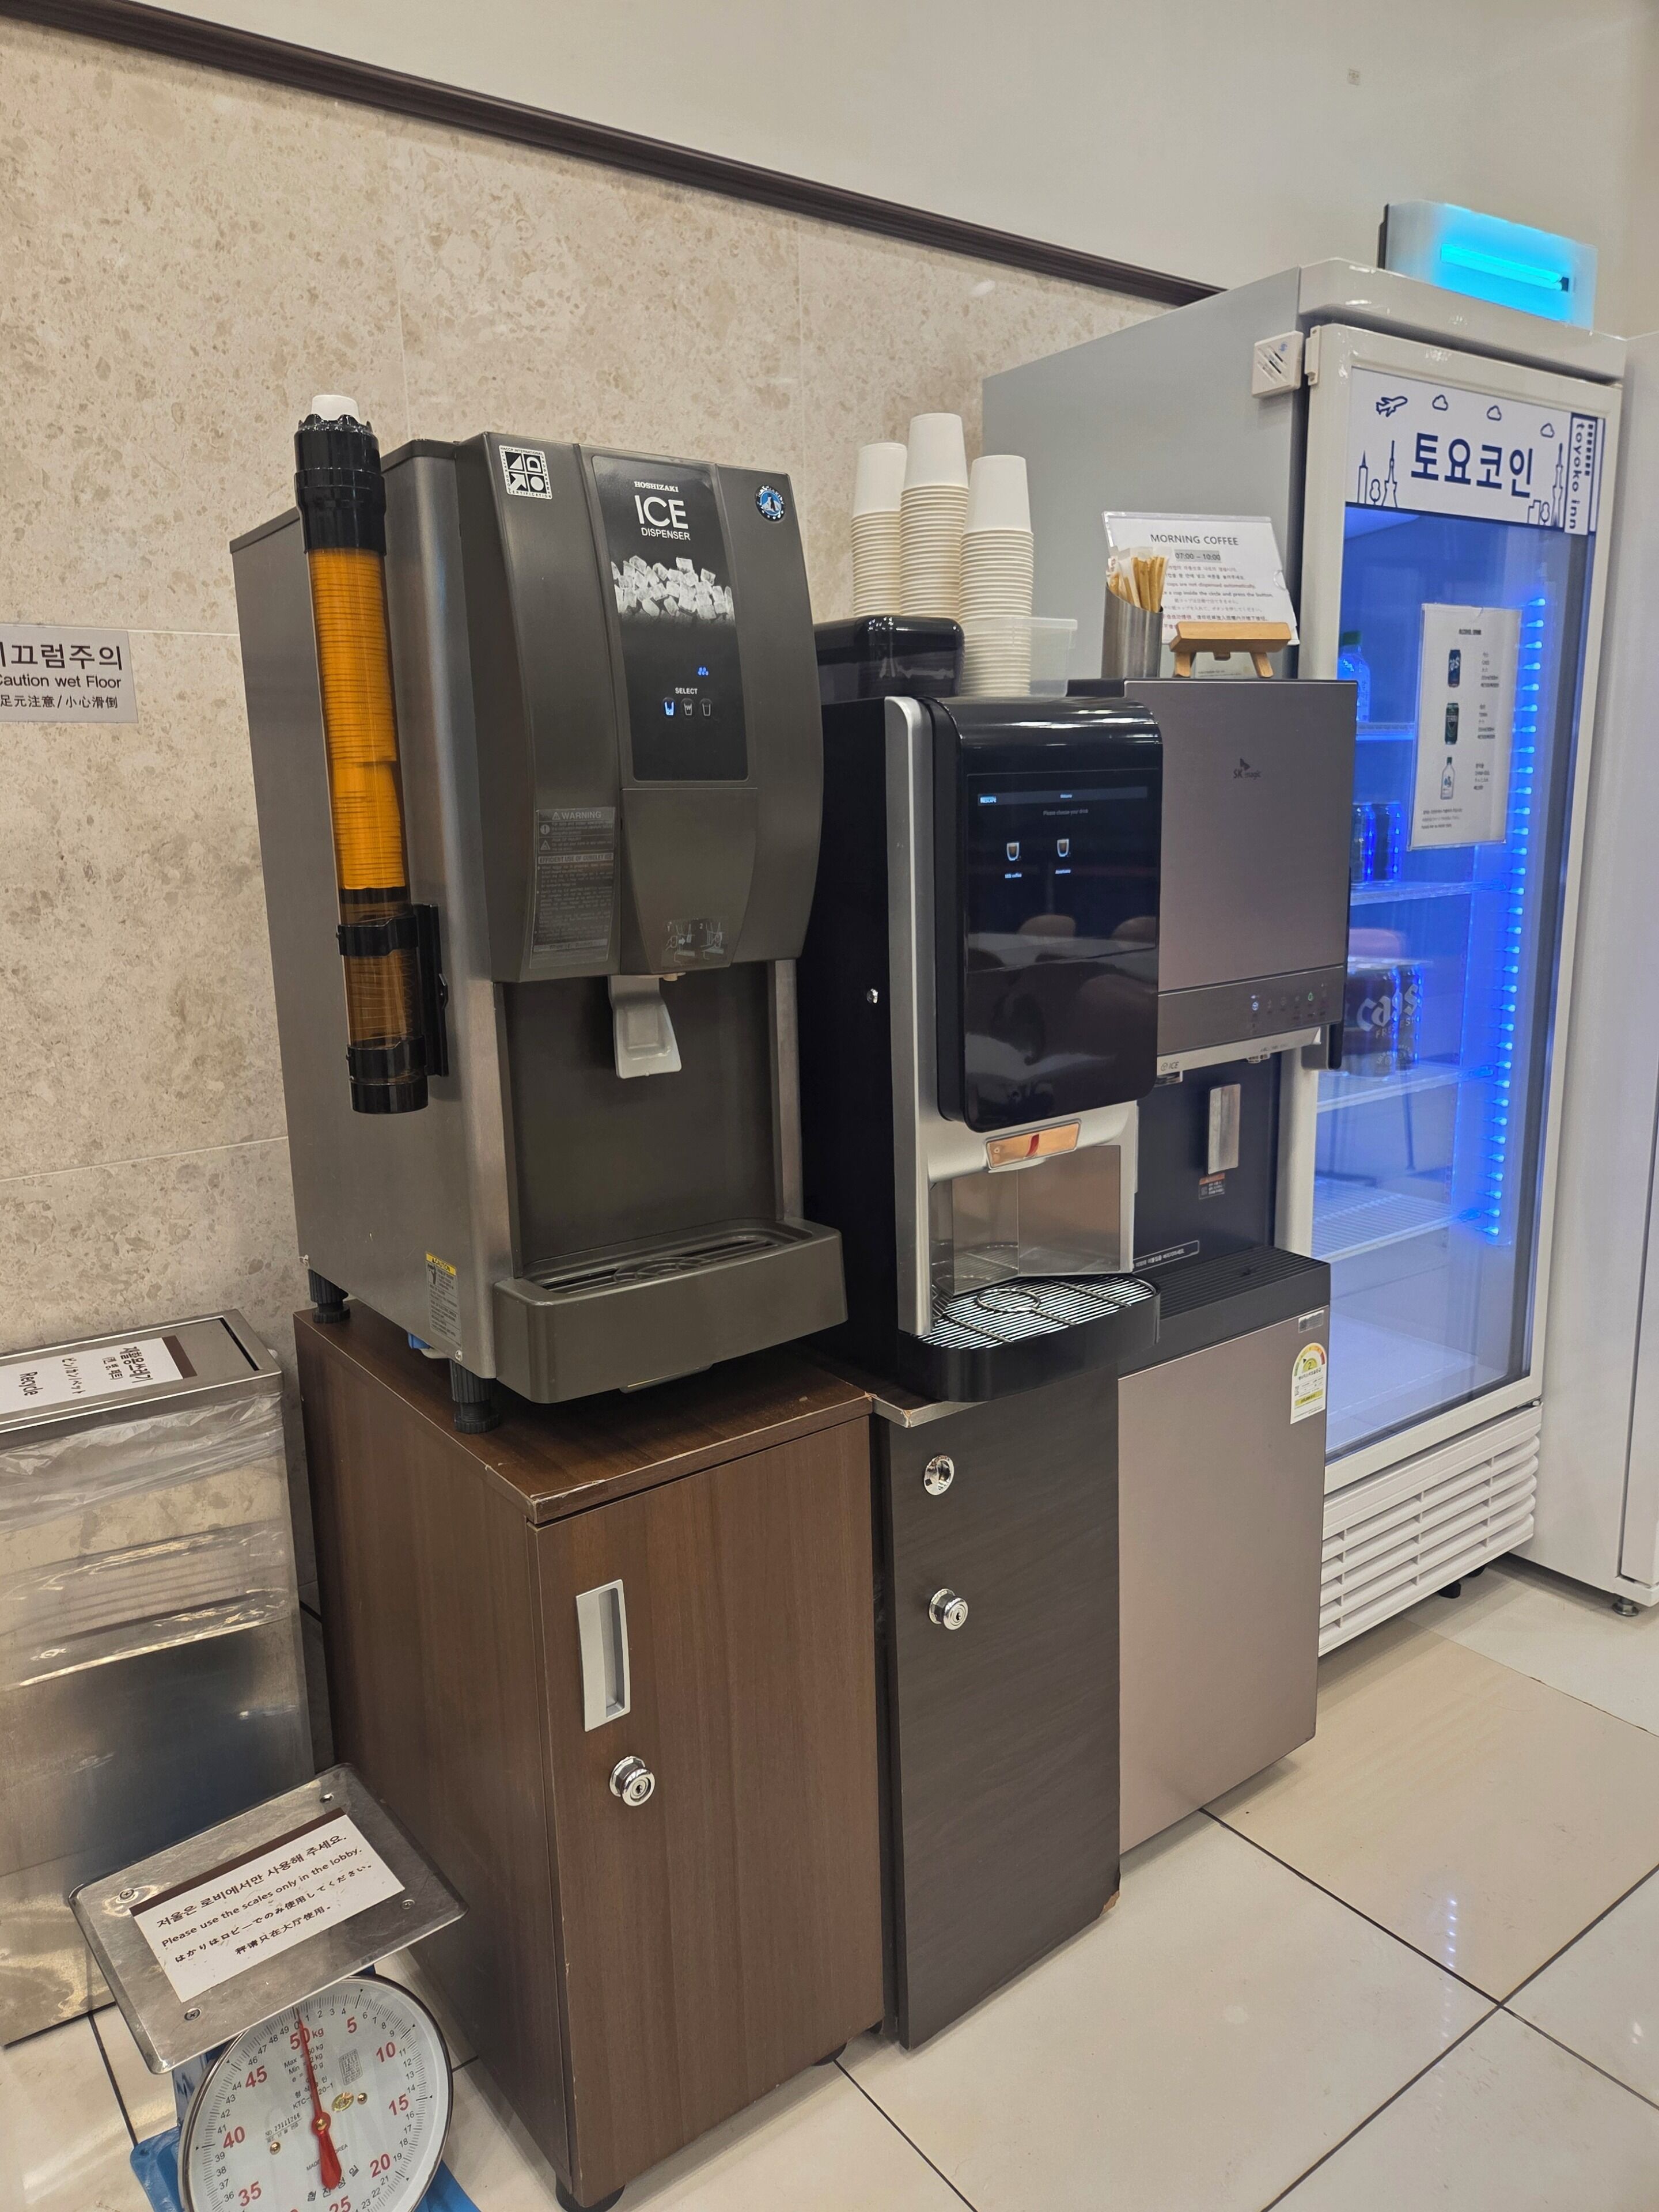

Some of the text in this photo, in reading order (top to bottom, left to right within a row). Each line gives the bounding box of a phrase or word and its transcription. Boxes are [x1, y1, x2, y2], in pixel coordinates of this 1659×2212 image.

[1411, 432, 1533, 498] 토요코인
[1569, 422, 1585, 529] toyoko inn
[634, 481, 679, 493] HOSHIZAKI
[634, 495, 688, 529] ICE
[641, 527, 691, 540] DISPENSER
[1150, 535, 1239, 546] MORNING COFFEE
[55, 676, 81, 687] wet
[86, 676, 122, 688] Floor
[562, 811, 601, 820] WARNING
[119, 1346, 153, 1383] 재활용쓰레기
[18, 1371, 44, 1396] Recycle
[157, 1834, 347, 1928] 저울은 로비에서만 사용해 주세요.
[162, 1848, 362, 1947] Please use the scales only in the lobby.
[317, 2010, 323, 2018] 2
[280, 2026, 289, 2035] 49
[347, 2017, 357, 2033] 5
[269, 2035, 278, 2044] 48
[290, 2028, 324, 2050] 50 kg
[258, 2044, 267, 2054] 47
[376, 2041, 396, 2063] 10
[399, 2048, 406, 2056] 11
[248, 2056, 257, 2065] 46
[284, 2058, 297, 2069] Max
[316, 2043, 324, 2051] kg
[289, 2066, 300, 2075] Min
[315, 2052, 323, 2061] kg
[403, 2058, 412, 2067] 12
[245, 2065, 267, 2088] 45
[406, 2071, 415, 2080] 13
[232, 2081, 241, 2091] 44
[407, 2084, 415, 2093] 14
[226, 2094, 236, 2104] 43
[389, 2094, 408, 2116] 15
[221, 2109, 230, 2119] 42
[406, 2111, 414, 2120] 16
[217, 2124, 226, 2134] 41
[404, 2124, 411, 2134] 17
[222, 2126, 245, 2149] 40
[399, 2138, 408, 2147] 18
[215, 2152, 225, 2162] 39
[393, 2153, 402, 2162] 19
[369, 2153, 391, 2178] 20
[216, 2166, 227, 2177] 38
[219, 2179, 229, 2190] 37
[380, 2176, 389, 2186] 21
[224, 2191, 234, 2202] 36
[238, 2180, 262, 2207] 35
[372, 2187, 381, 2198] 22
[361, 2198, 371, 2209] 23
